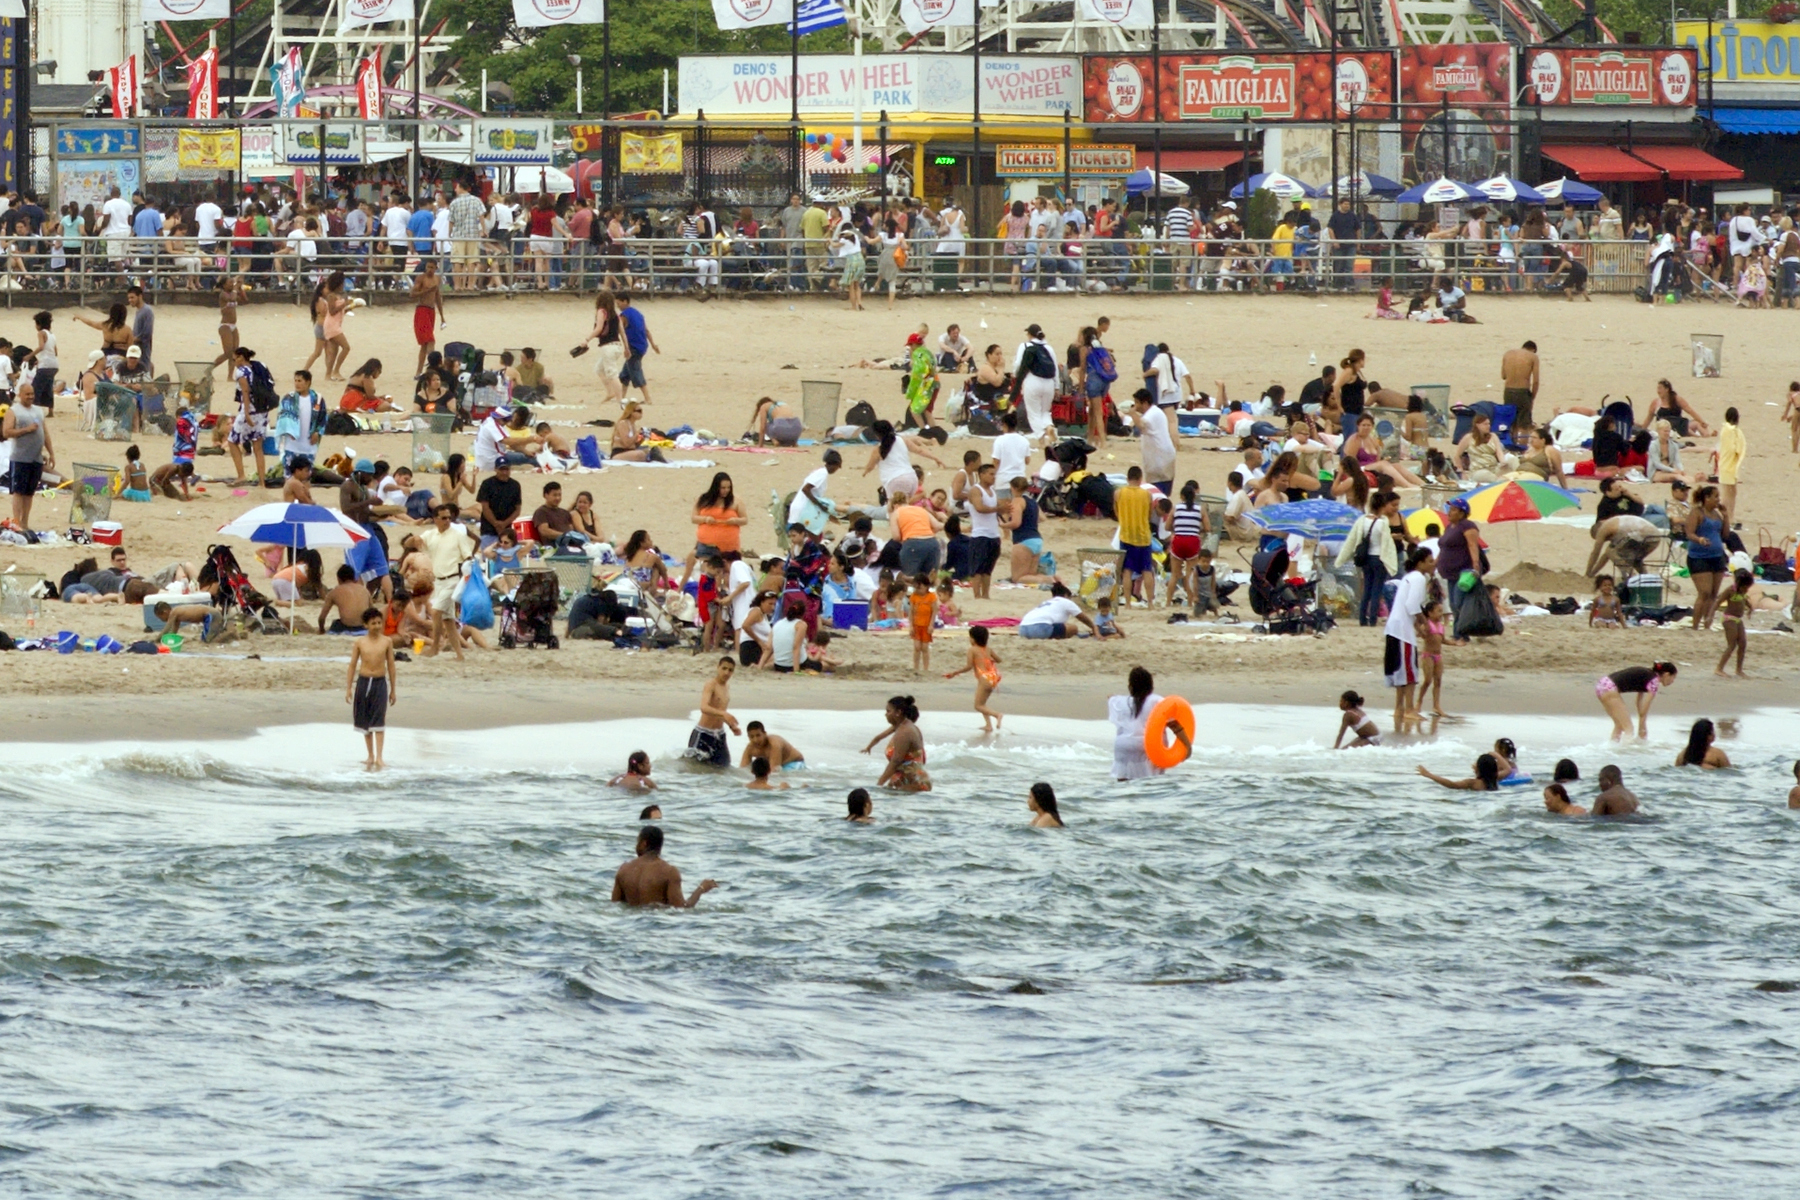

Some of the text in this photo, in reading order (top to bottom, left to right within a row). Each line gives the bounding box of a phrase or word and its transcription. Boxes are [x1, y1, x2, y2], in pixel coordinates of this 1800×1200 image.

[733, 63, 777, 76] DENO'S
[985, 62, 1020, 71] DENO'S
[734, 62, 913, 104] WONDER WHEEL
[985, 64, 1073, 91] WONDER
[1435, 73, 1476, 84] FAMIGLIA
[1538, 73, 1557, 83] SNACK
[1575, 70, 1648, 92] FAMIGLIA
[1667, 74, 1687, 84] SNACK
[999, 82, 1064, 103] WHEEL
[1115, 85, 1136, 96] SNACK
[1185, 78, 1287, 105] FAMIGLIA
[1541, 84, 1554, 93] BAR
[1671, 85, 1684, 94] BAR
[873, 90, 913, 106] PARK
[1119, 95, 1134, 106] BAR
[1045, 100, 1073, 110] PARK
[934, 156, 956, 165] ATM
[1005, 152, 1055, 165] TICKETS
[1070, 152, 1128, 166] TICKETS
